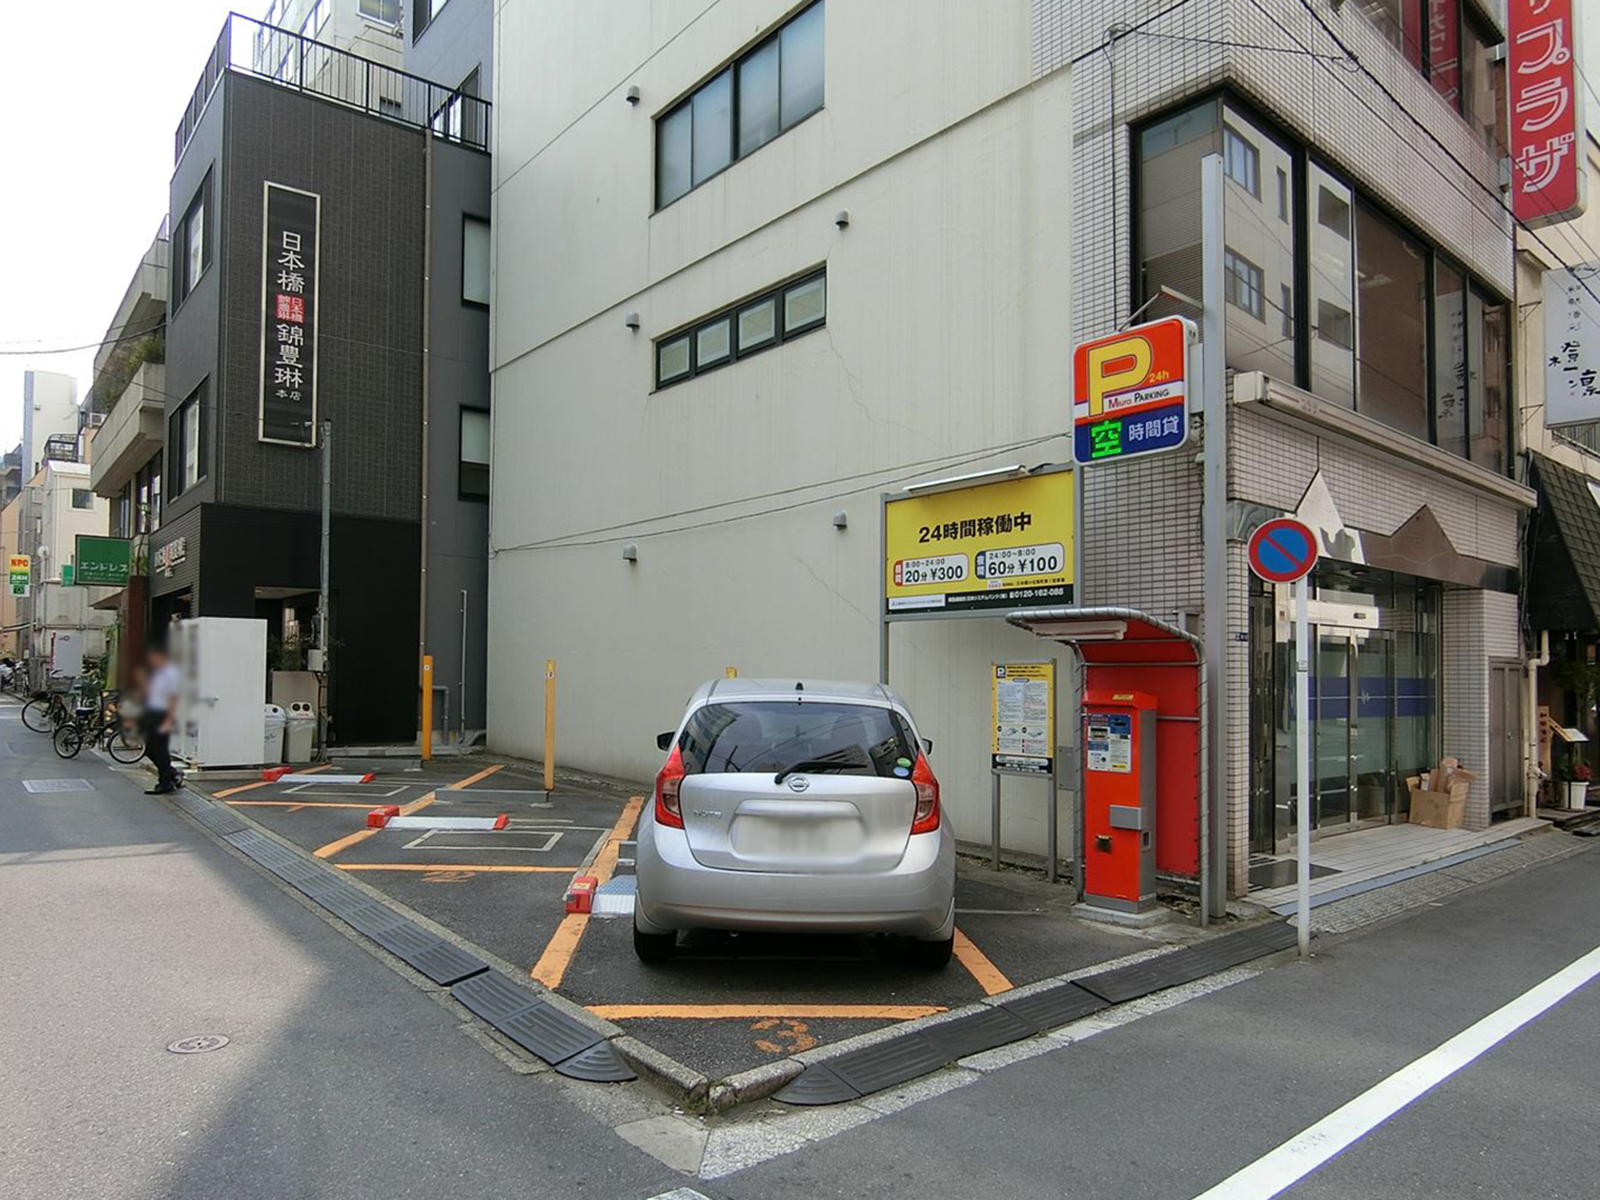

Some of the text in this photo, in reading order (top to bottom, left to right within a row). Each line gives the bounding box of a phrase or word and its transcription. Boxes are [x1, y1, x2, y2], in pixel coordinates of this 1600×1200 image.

[275, 231, 305, 389] 日本橋 錦豊琳
[1088, 336, 1152, 418] P
[1149, 370, 1170, 383] 24h
[1091, 420, 1123, 458] 空
[1128, 415, 1180, 442] 時間貸
[919, 512, 1032, 543] 24時間稼働中
[80, 561, 128, 573] エンドレス
